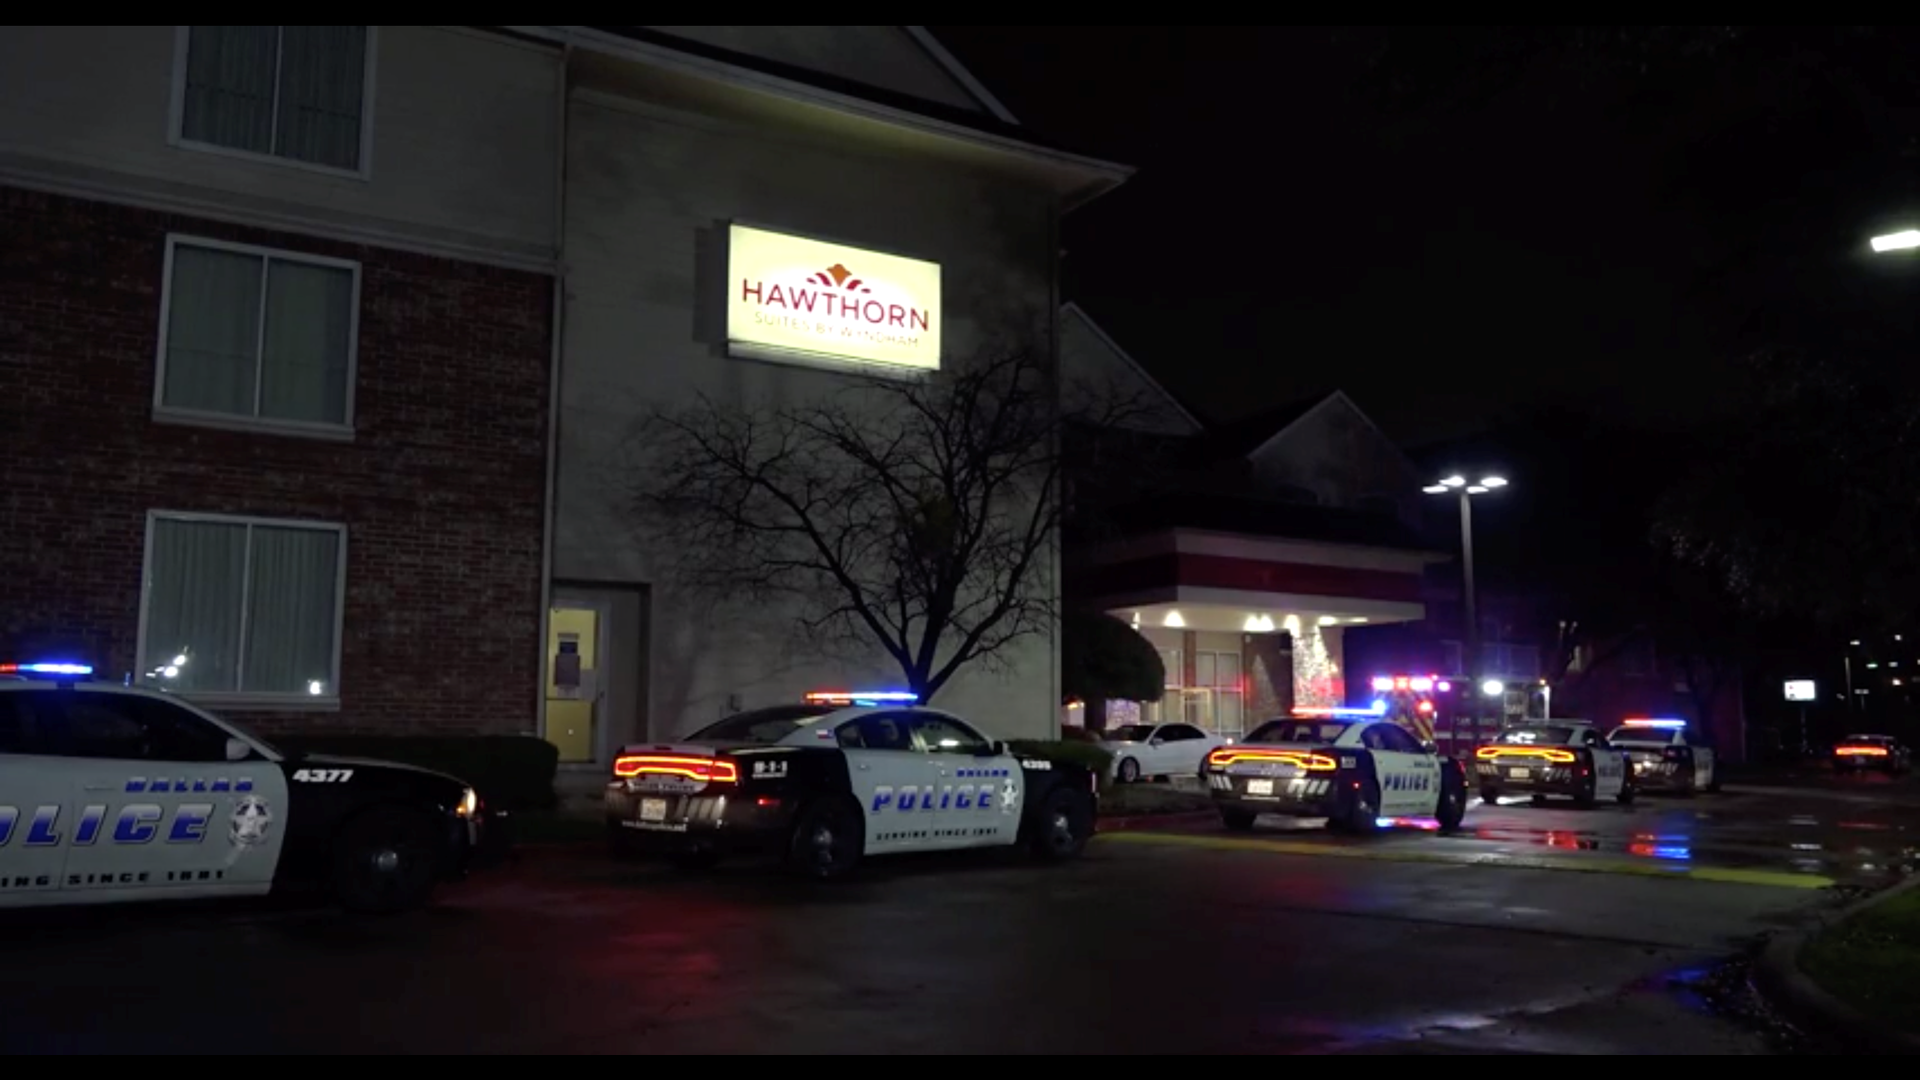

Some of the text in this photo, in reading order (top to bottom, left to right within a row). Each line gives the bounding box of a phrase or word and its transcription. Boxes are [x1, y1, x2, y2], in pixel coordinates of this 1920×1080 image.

[742, 278, 929, 332] HAWTHORN
[754, 311, 919, 348] SUITES BY WYNDHAM
[125, 776, 254, 793] DALLAS
[292, 769, 355, 783] 4377
[1384, 772, 1429, 791] POLICE
[871, 784, 996, 812] POLICE
[1, 876, 50, 888] ING
[69, 872, 150, 885] SINCE
